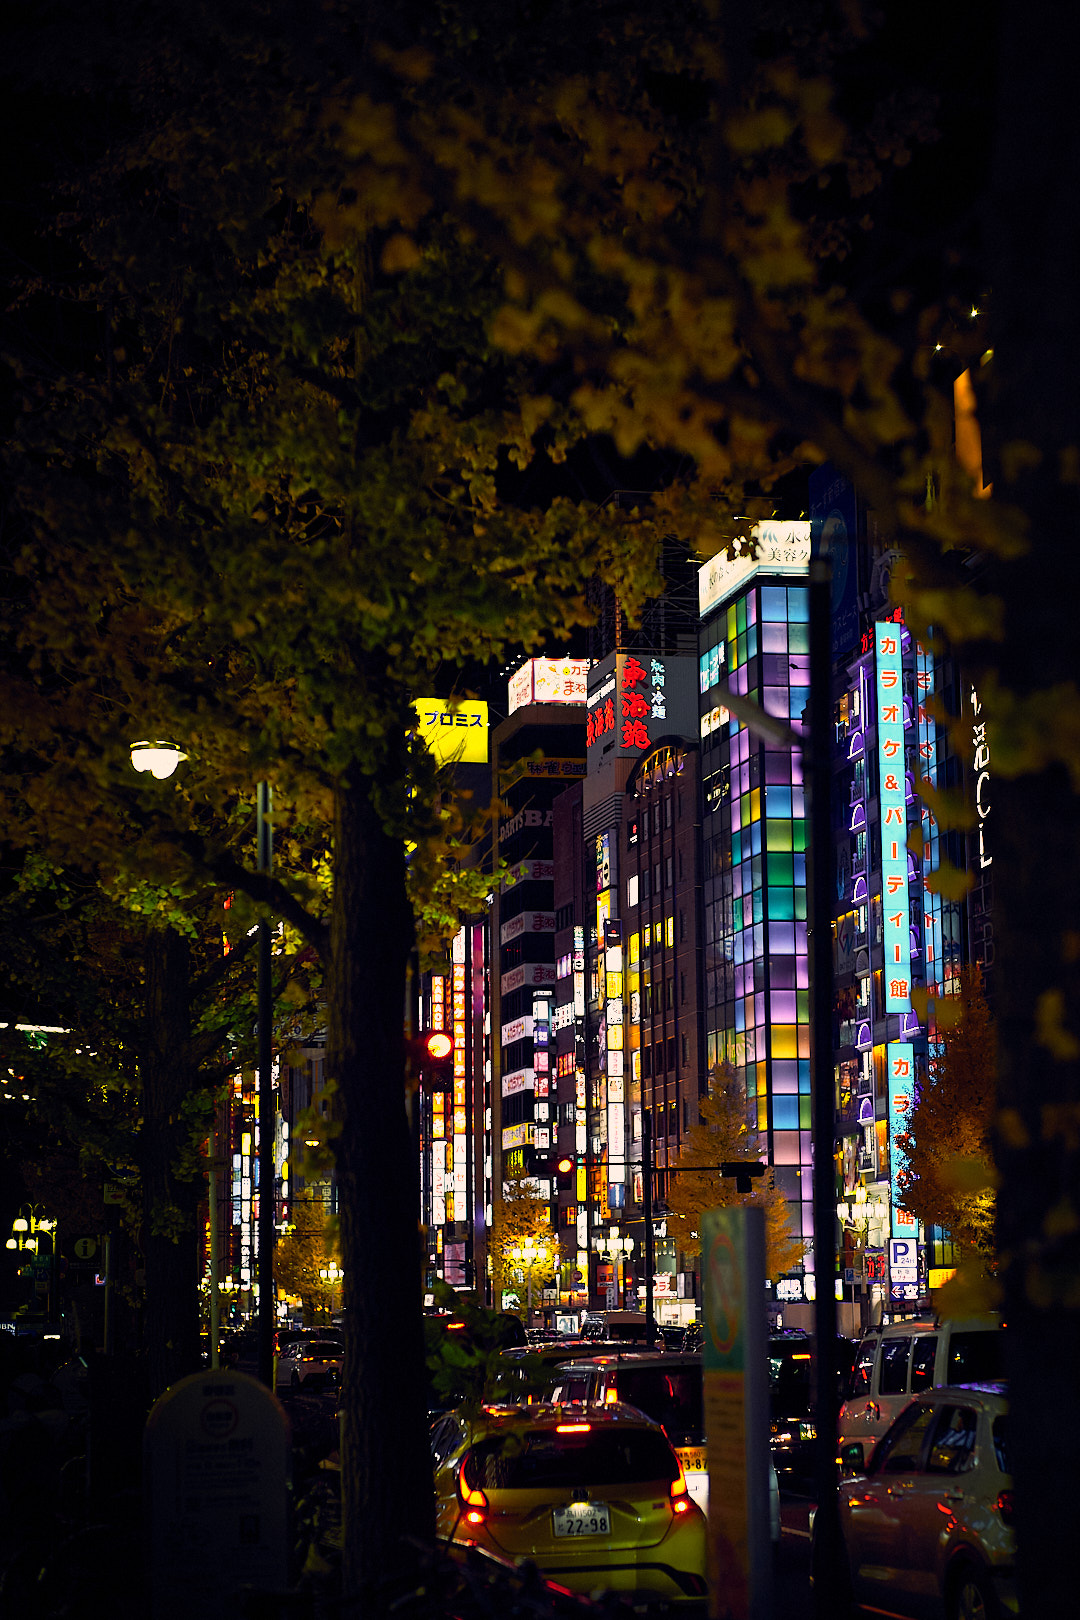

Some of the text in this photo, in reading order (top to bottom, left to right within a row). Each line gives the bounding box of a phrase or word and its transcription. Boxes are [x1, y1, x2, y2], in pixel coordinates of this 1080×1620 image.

[620, 657, 652, 749] 東海苑
[424, 711, 483, 728] プロミス
[500, 812, 524, 843] DARTS
[880, 637, 909, 999] カラオケ&パーティー館
[434, 976, 443, 1030] KARAOK
[893, 1242, 909, 1264] P
[680, 1458, 708, 1470] 3-87
[566, 1517, 607, 1534] 22-98
